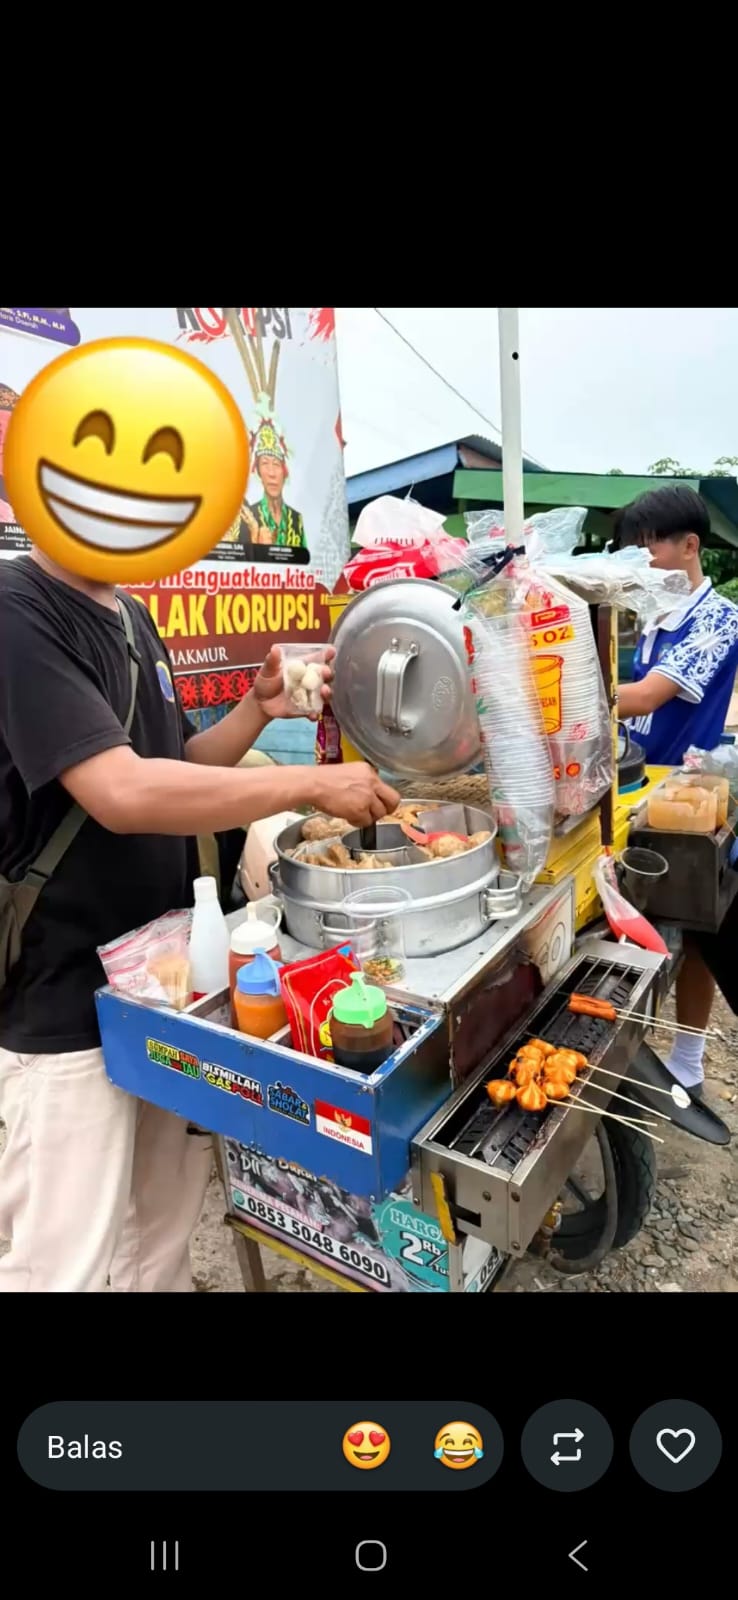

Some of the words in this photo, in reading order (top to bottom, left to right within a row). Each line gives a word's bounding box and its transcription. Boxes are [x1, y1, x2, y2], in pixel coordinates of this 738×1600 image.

[176, 307, 292, 339] KOUPSI
[160, 566, 284, 595] menguatkan
[131, 594, 209, 638] LAK
[202, 1062, 260, 1093] BISMILLAH
[323, 1126, 365, 1150] INDONESIA
[248, 1197, 286, 1228] 0853
[291, 1218, 334, 1253] 5048
[339, 1245, 385, 1280] 6090
